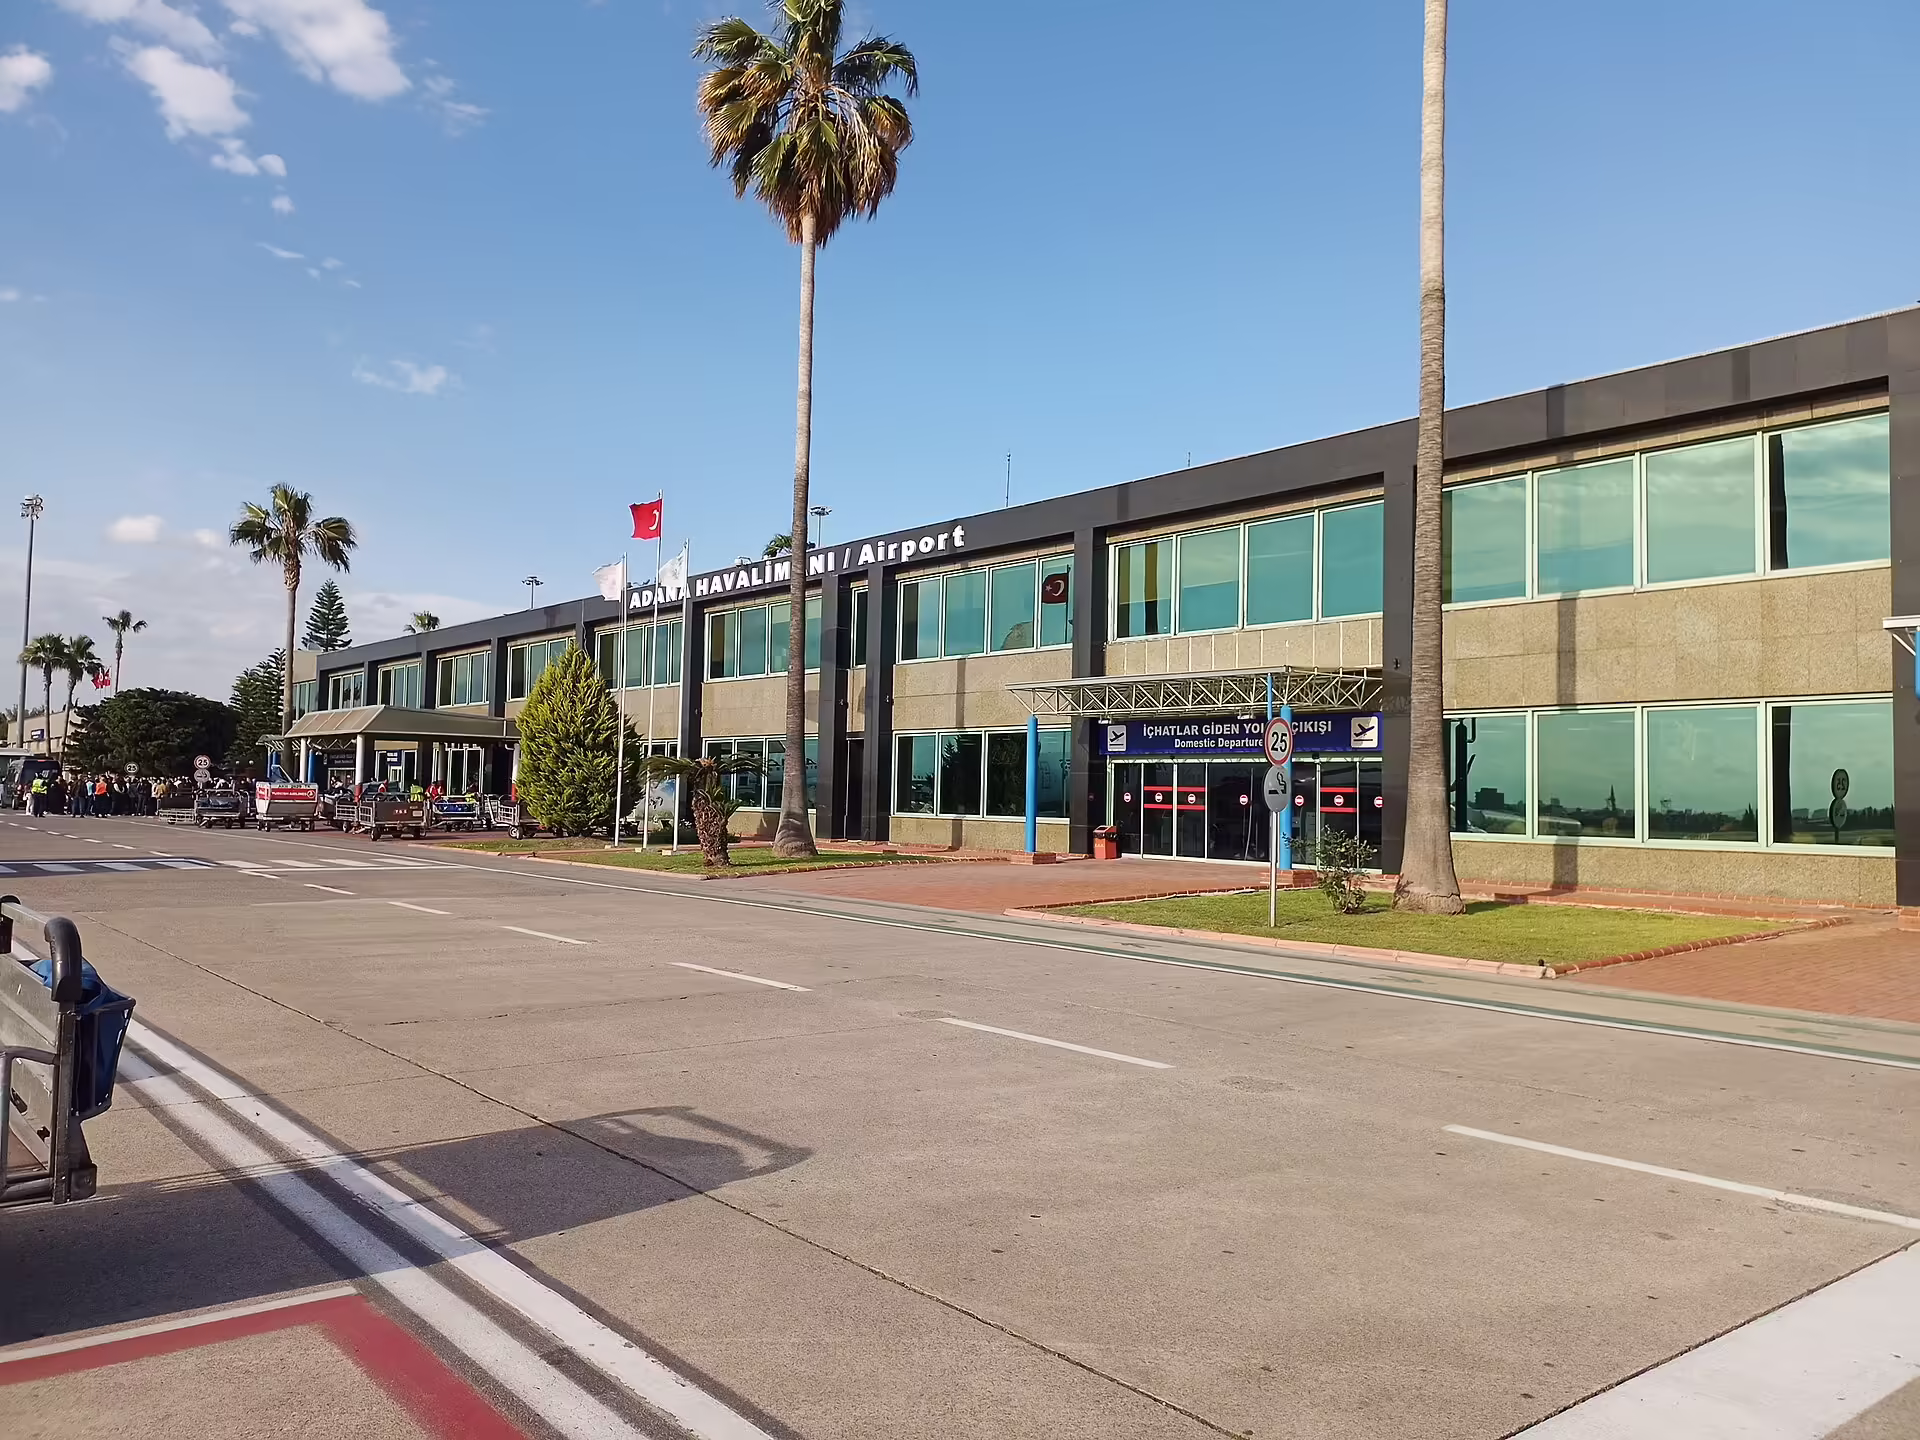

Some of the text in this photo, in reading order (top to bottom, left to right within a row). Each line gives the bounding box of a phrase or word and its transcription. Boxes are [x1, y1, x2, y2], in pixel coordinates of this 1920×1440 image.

[629, 583, 692, 609] ADANA
[695, 551, 836, 597] HAVALİMNI
[857, 525, 965, 563] Airport
[1143, 723, 1199, 739] İÇHATLAR
[1202, 721, 1240, 736] GİDEN
[1174, 737, 1264, 749] Domestic Departure
[1271, 731, 1288, 753] 25
[127, 764, 138, 772] 25
